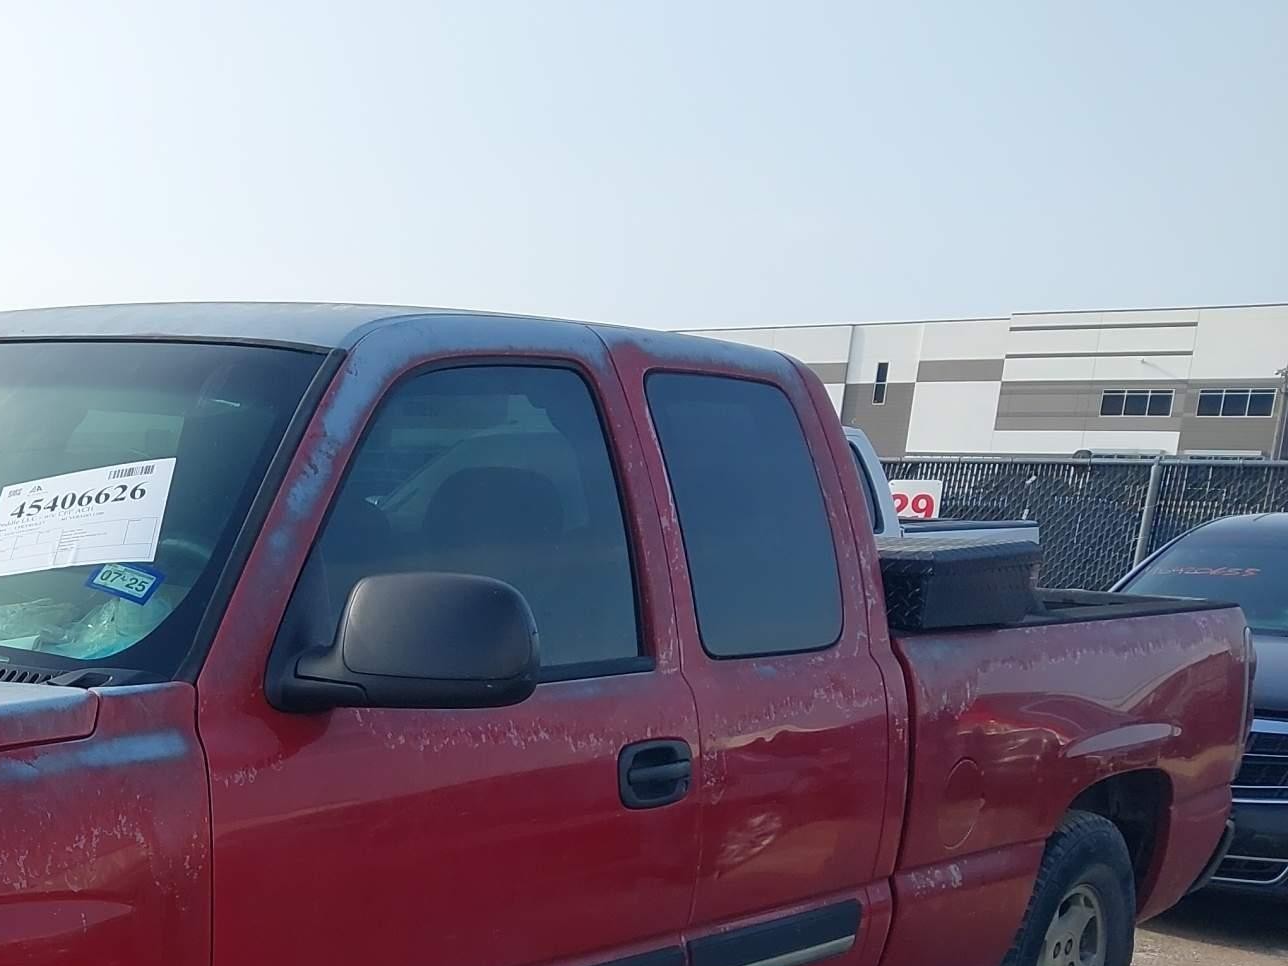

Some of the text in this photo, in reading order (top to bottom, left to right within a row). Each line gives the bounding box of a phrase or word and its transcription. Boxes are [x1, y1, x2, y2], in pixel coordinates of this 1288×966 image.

[10, 481, 150, 518] 45406626
[100, 569, 122, 583] 07
[125, 577, 149, 592] 25
